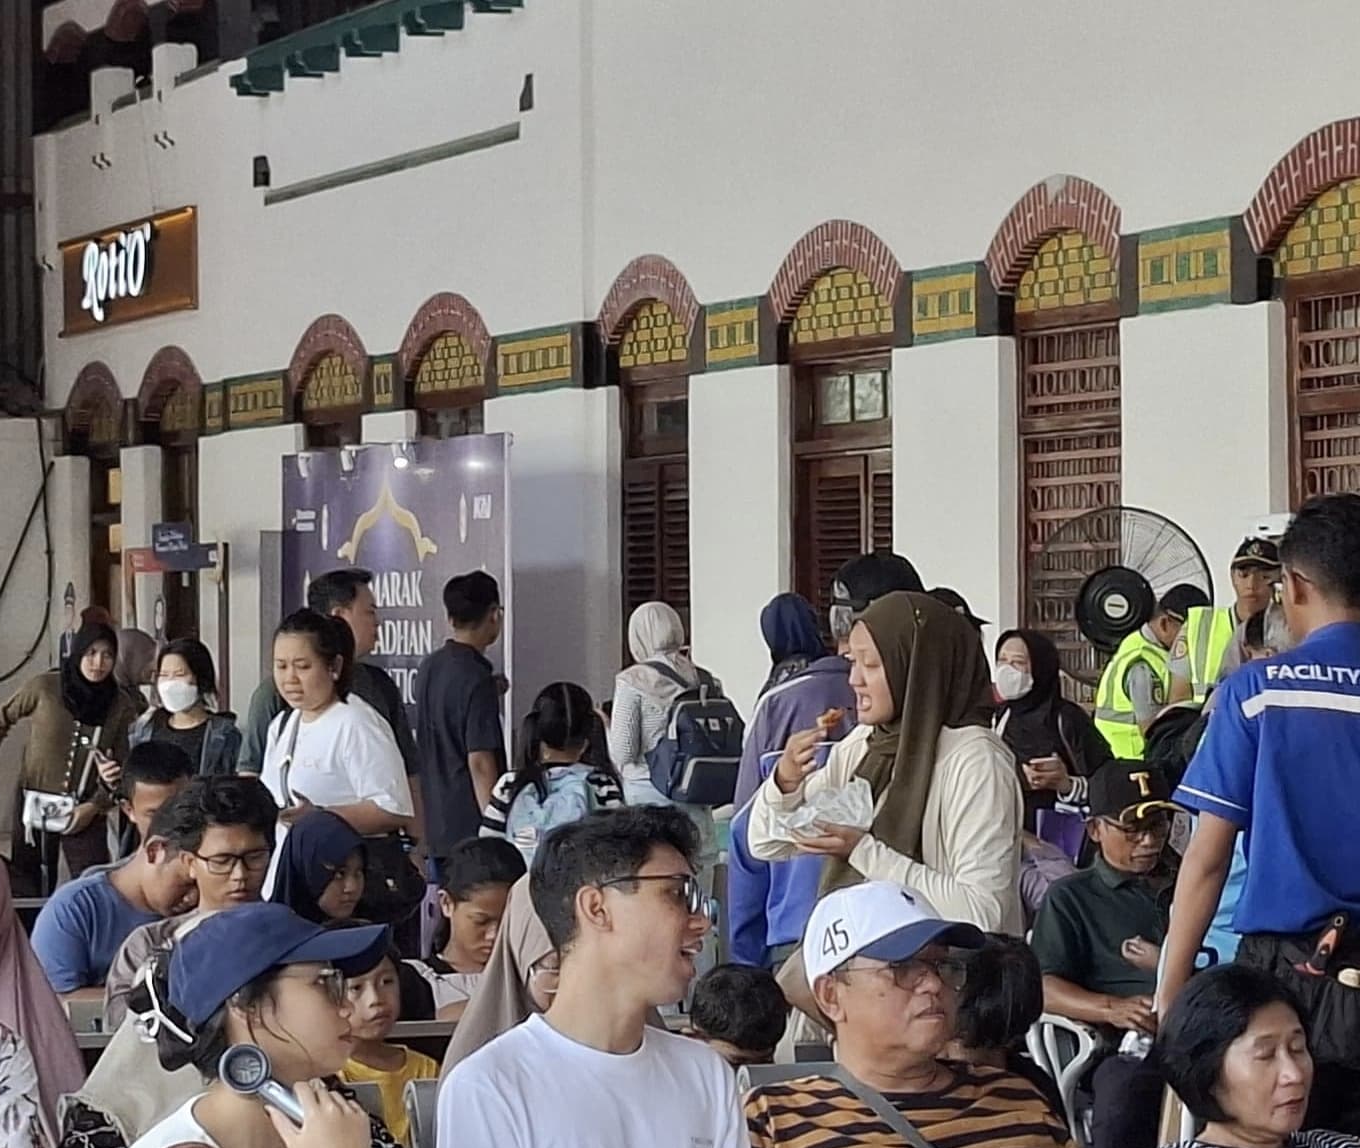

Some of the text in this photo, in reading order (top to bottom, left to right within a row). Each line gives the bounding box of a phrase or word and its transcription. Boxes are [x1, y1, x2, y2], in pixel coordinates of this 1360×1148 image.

[367, 570, 423, 608] MARAK
[370, 619, 432, 655] ADHAN
[1266, 664, 1360, 685] FACILITY
[1129, 771, 1150, 797] T
[823, 918, 849, 956] 45
